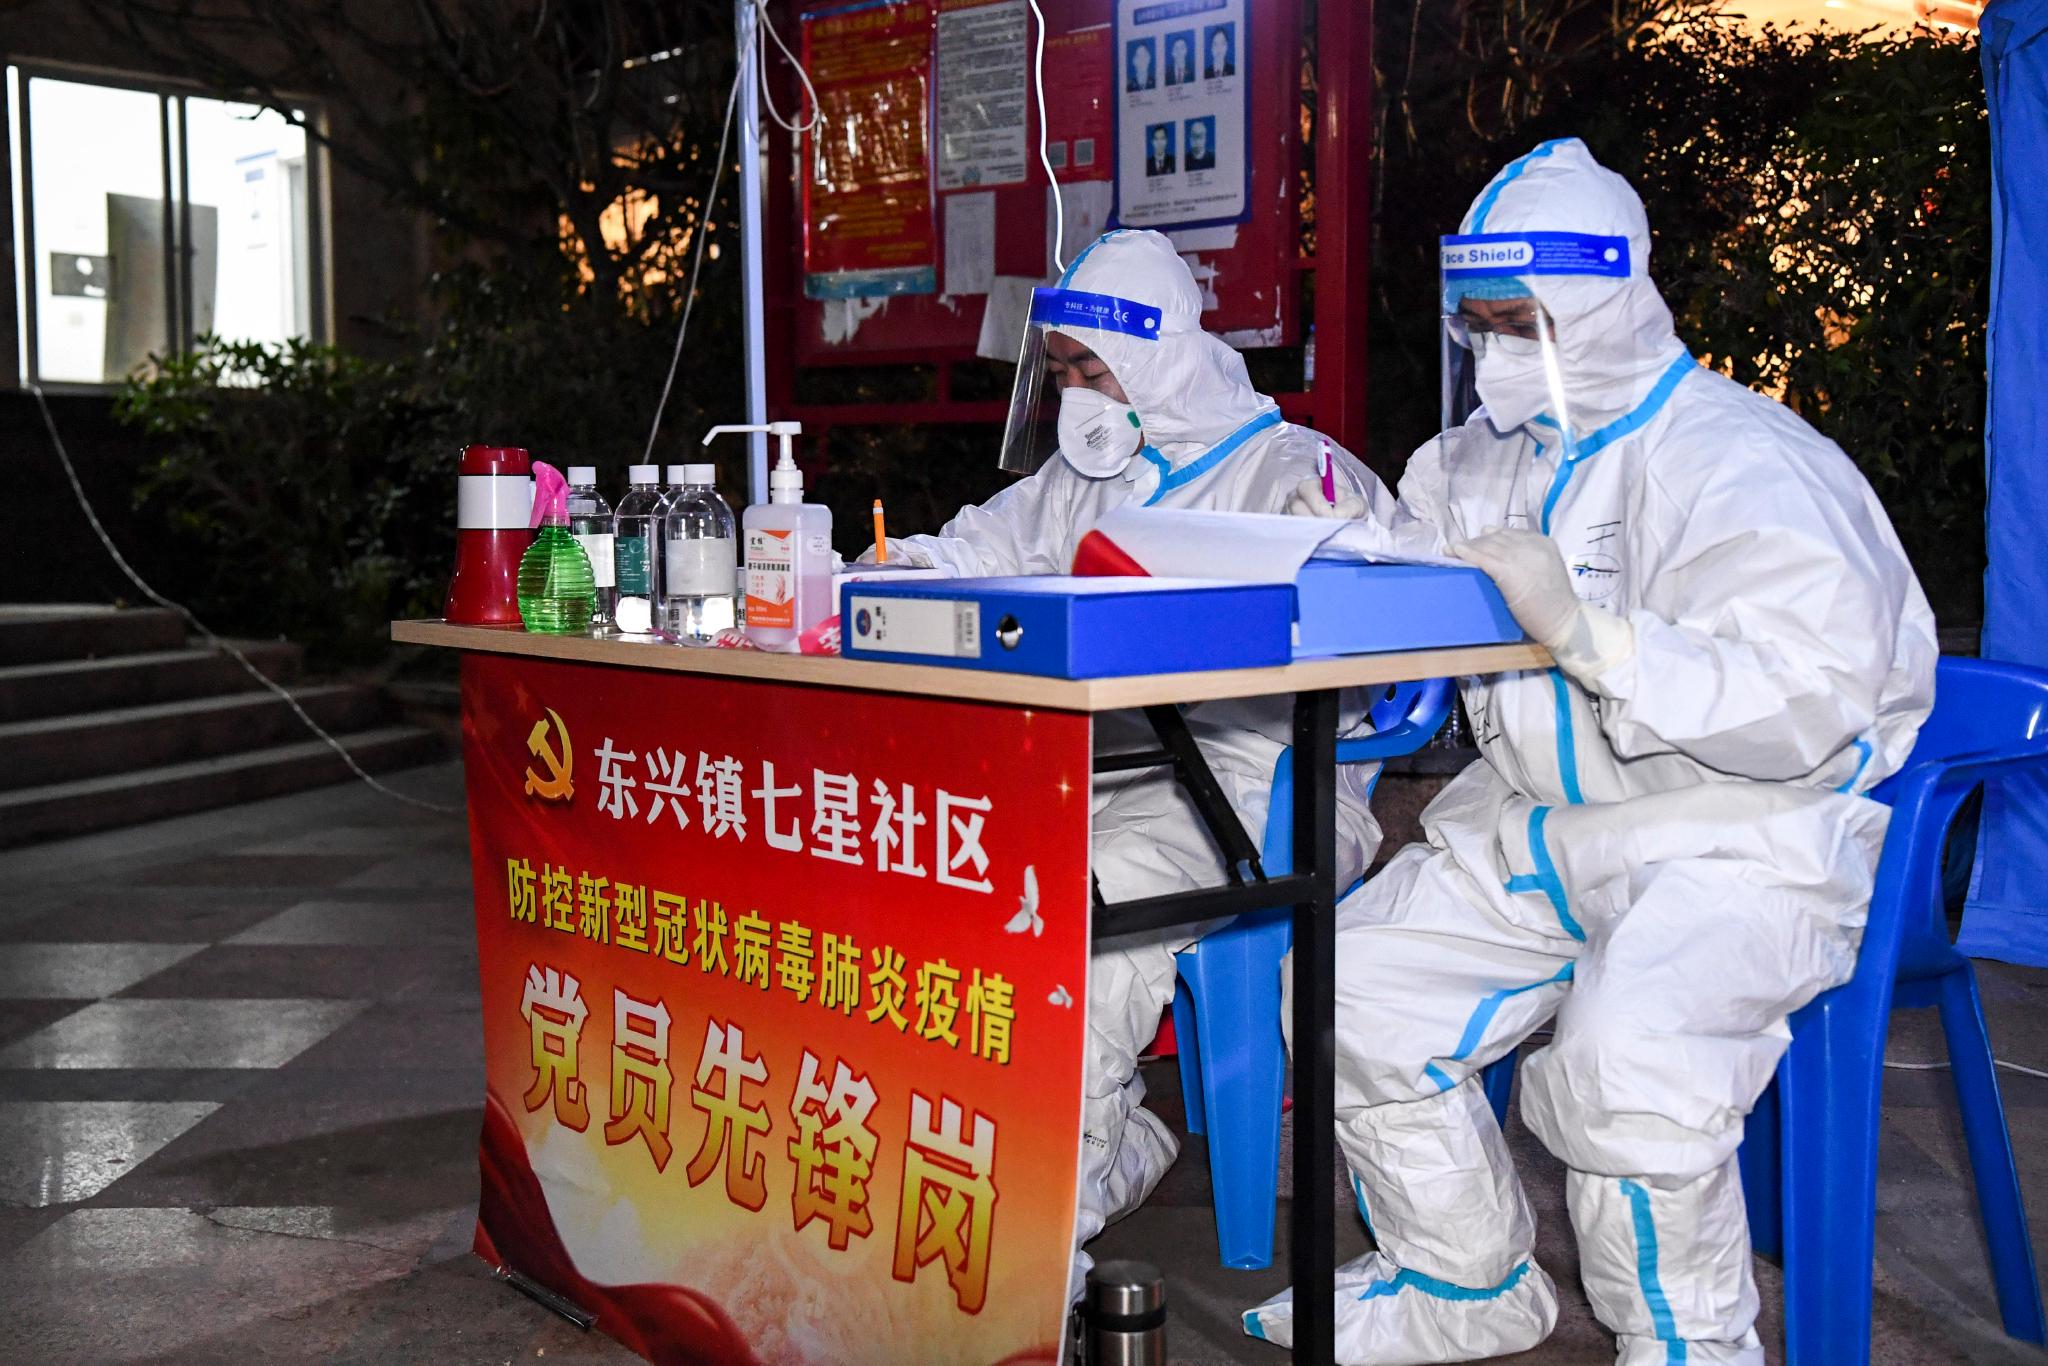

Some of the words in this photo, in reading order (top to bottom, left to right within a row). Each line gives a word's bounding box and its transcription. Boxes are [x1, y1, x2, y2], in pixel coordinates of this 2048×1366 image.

[1470, 248, 1525, 262] Shield
[594, 738, 994, 893] 东兴镇七星社区
[507, 859, 1016, 1064] 防控新型冠状病毒肺炎疫情
[519, 963, 1003, 1315] 党员先锋岗
